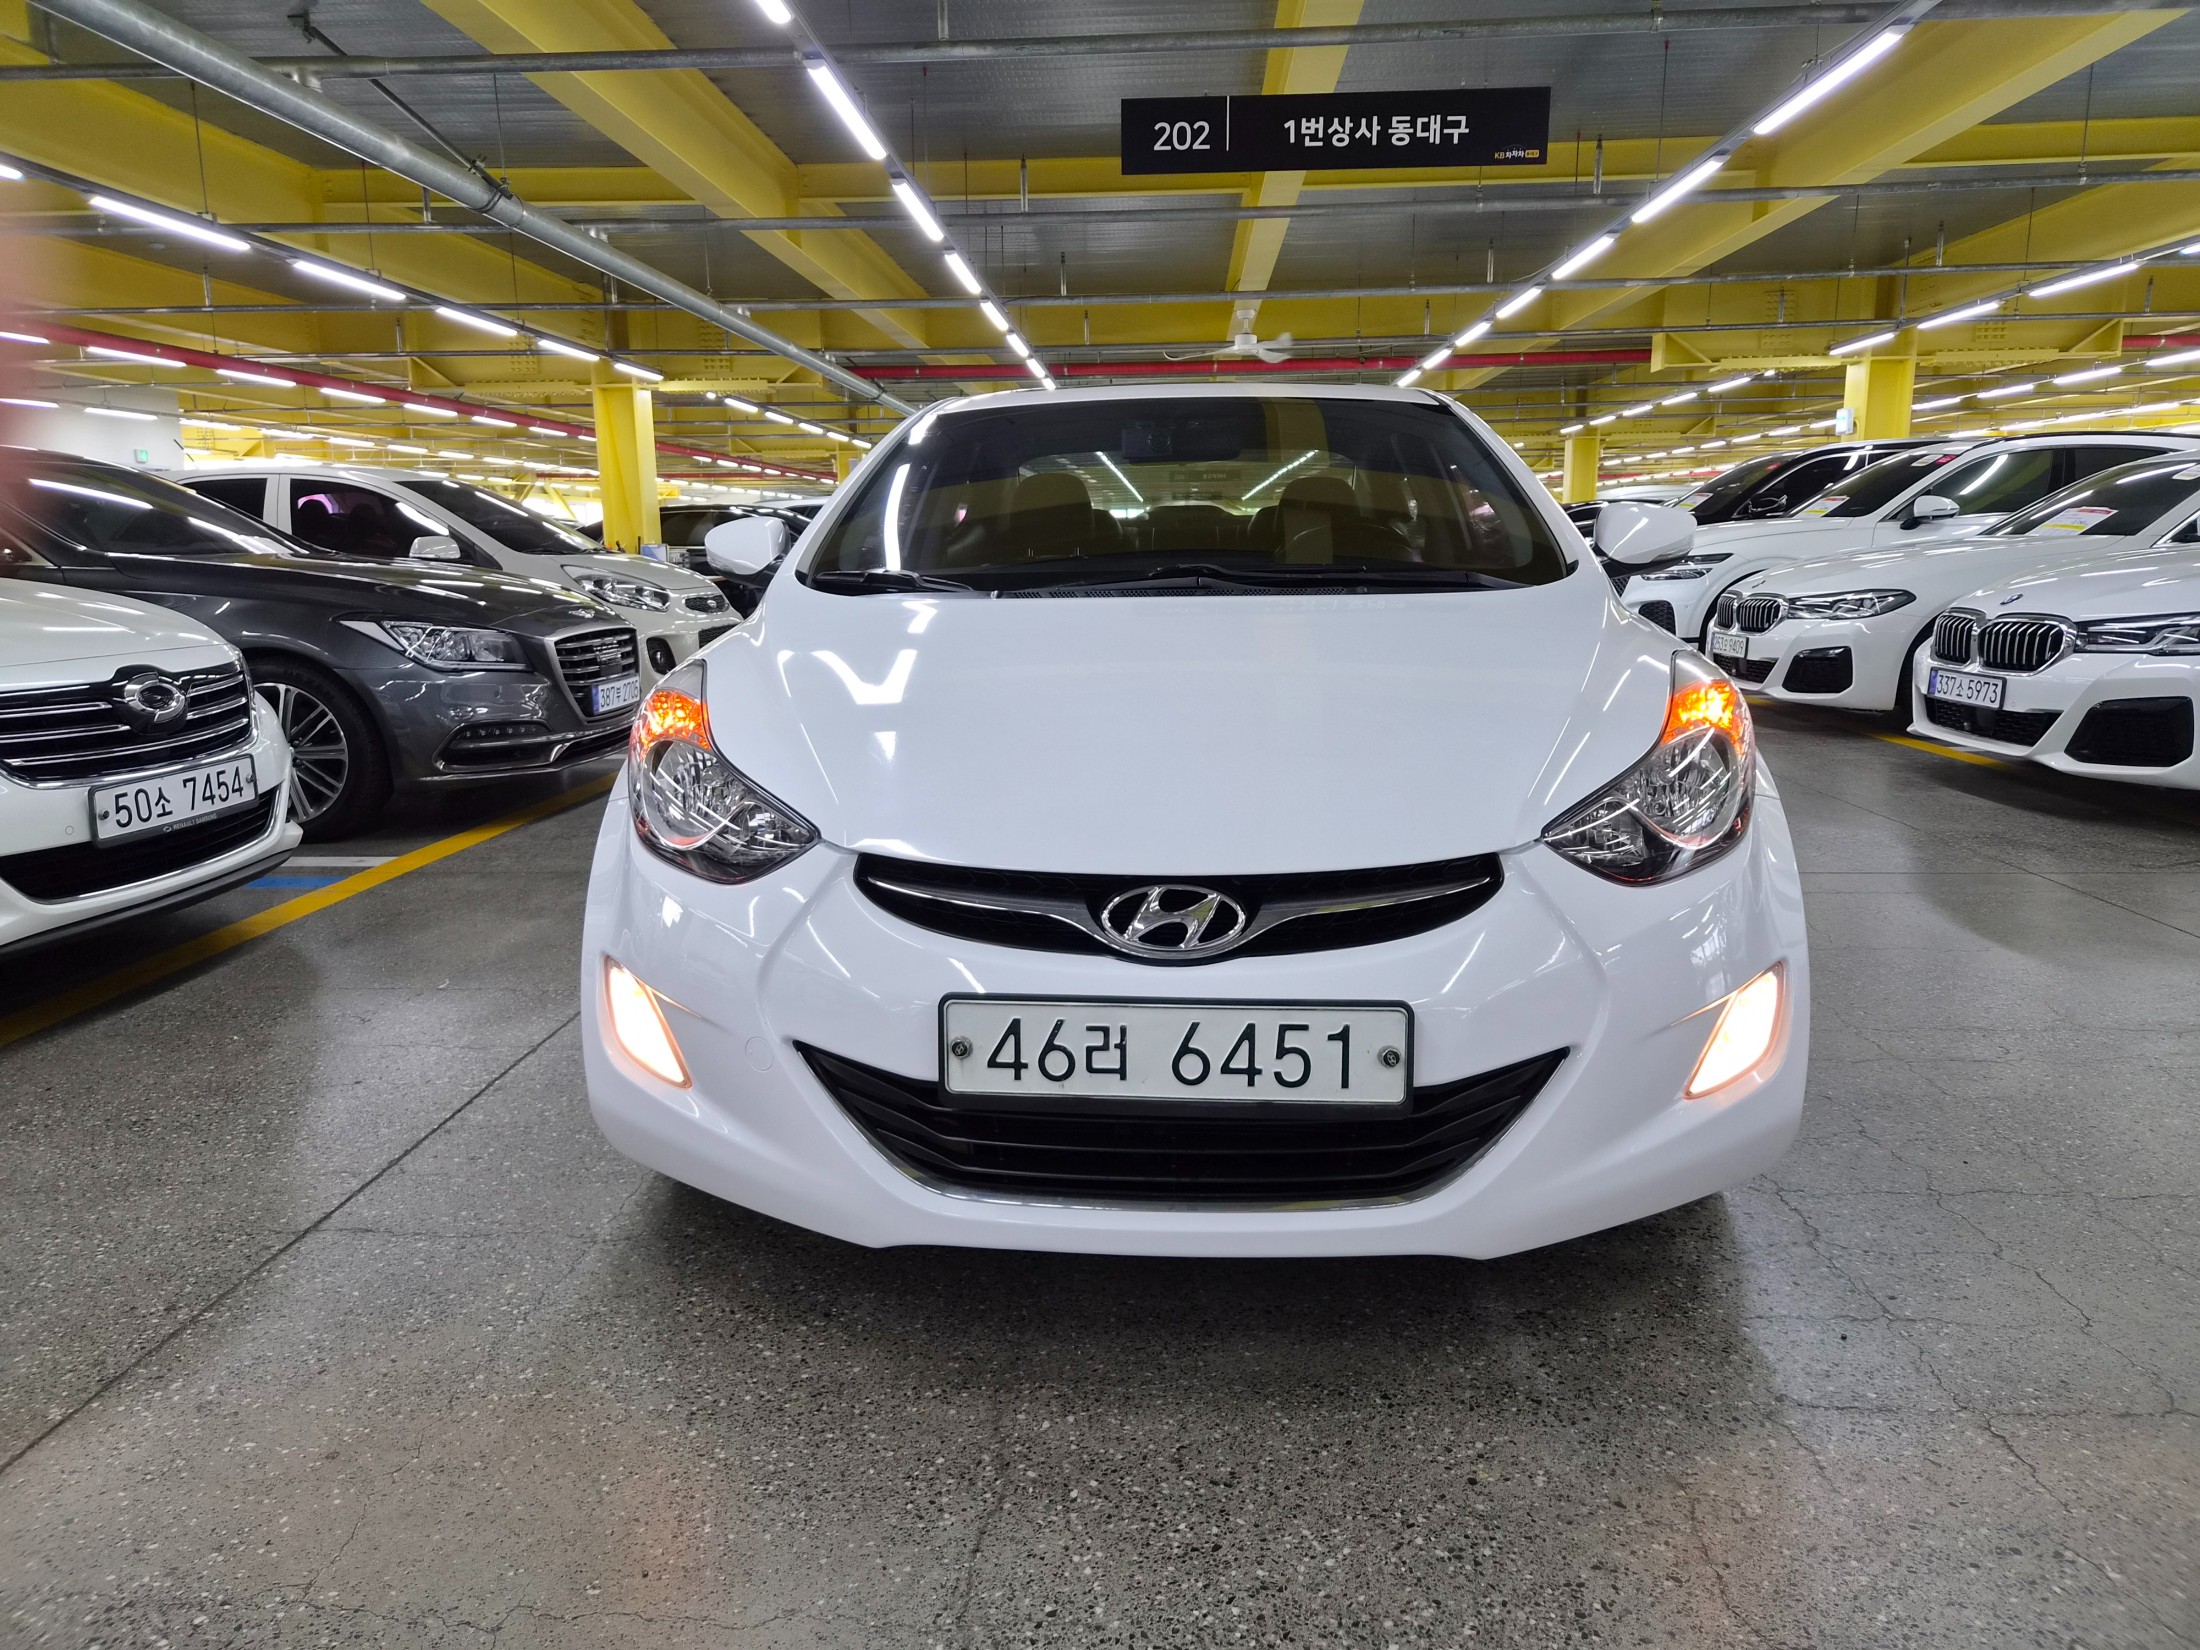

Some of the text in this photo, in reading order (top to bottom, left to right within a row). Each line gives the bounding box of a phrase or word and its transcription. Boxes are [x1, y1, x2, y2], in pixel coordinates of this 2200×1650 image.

[1153, 121, 1210, 151] 202
[1283, 114, 1470, 147] 1번상사 동대구
[1494, 151, 1505, 160] KB
[1937, 674, 1999, 704] 337소 5973
[114, 766, 244, 828] 50소 7454
[986, 1017, 1350, 1089] 46러 6451
